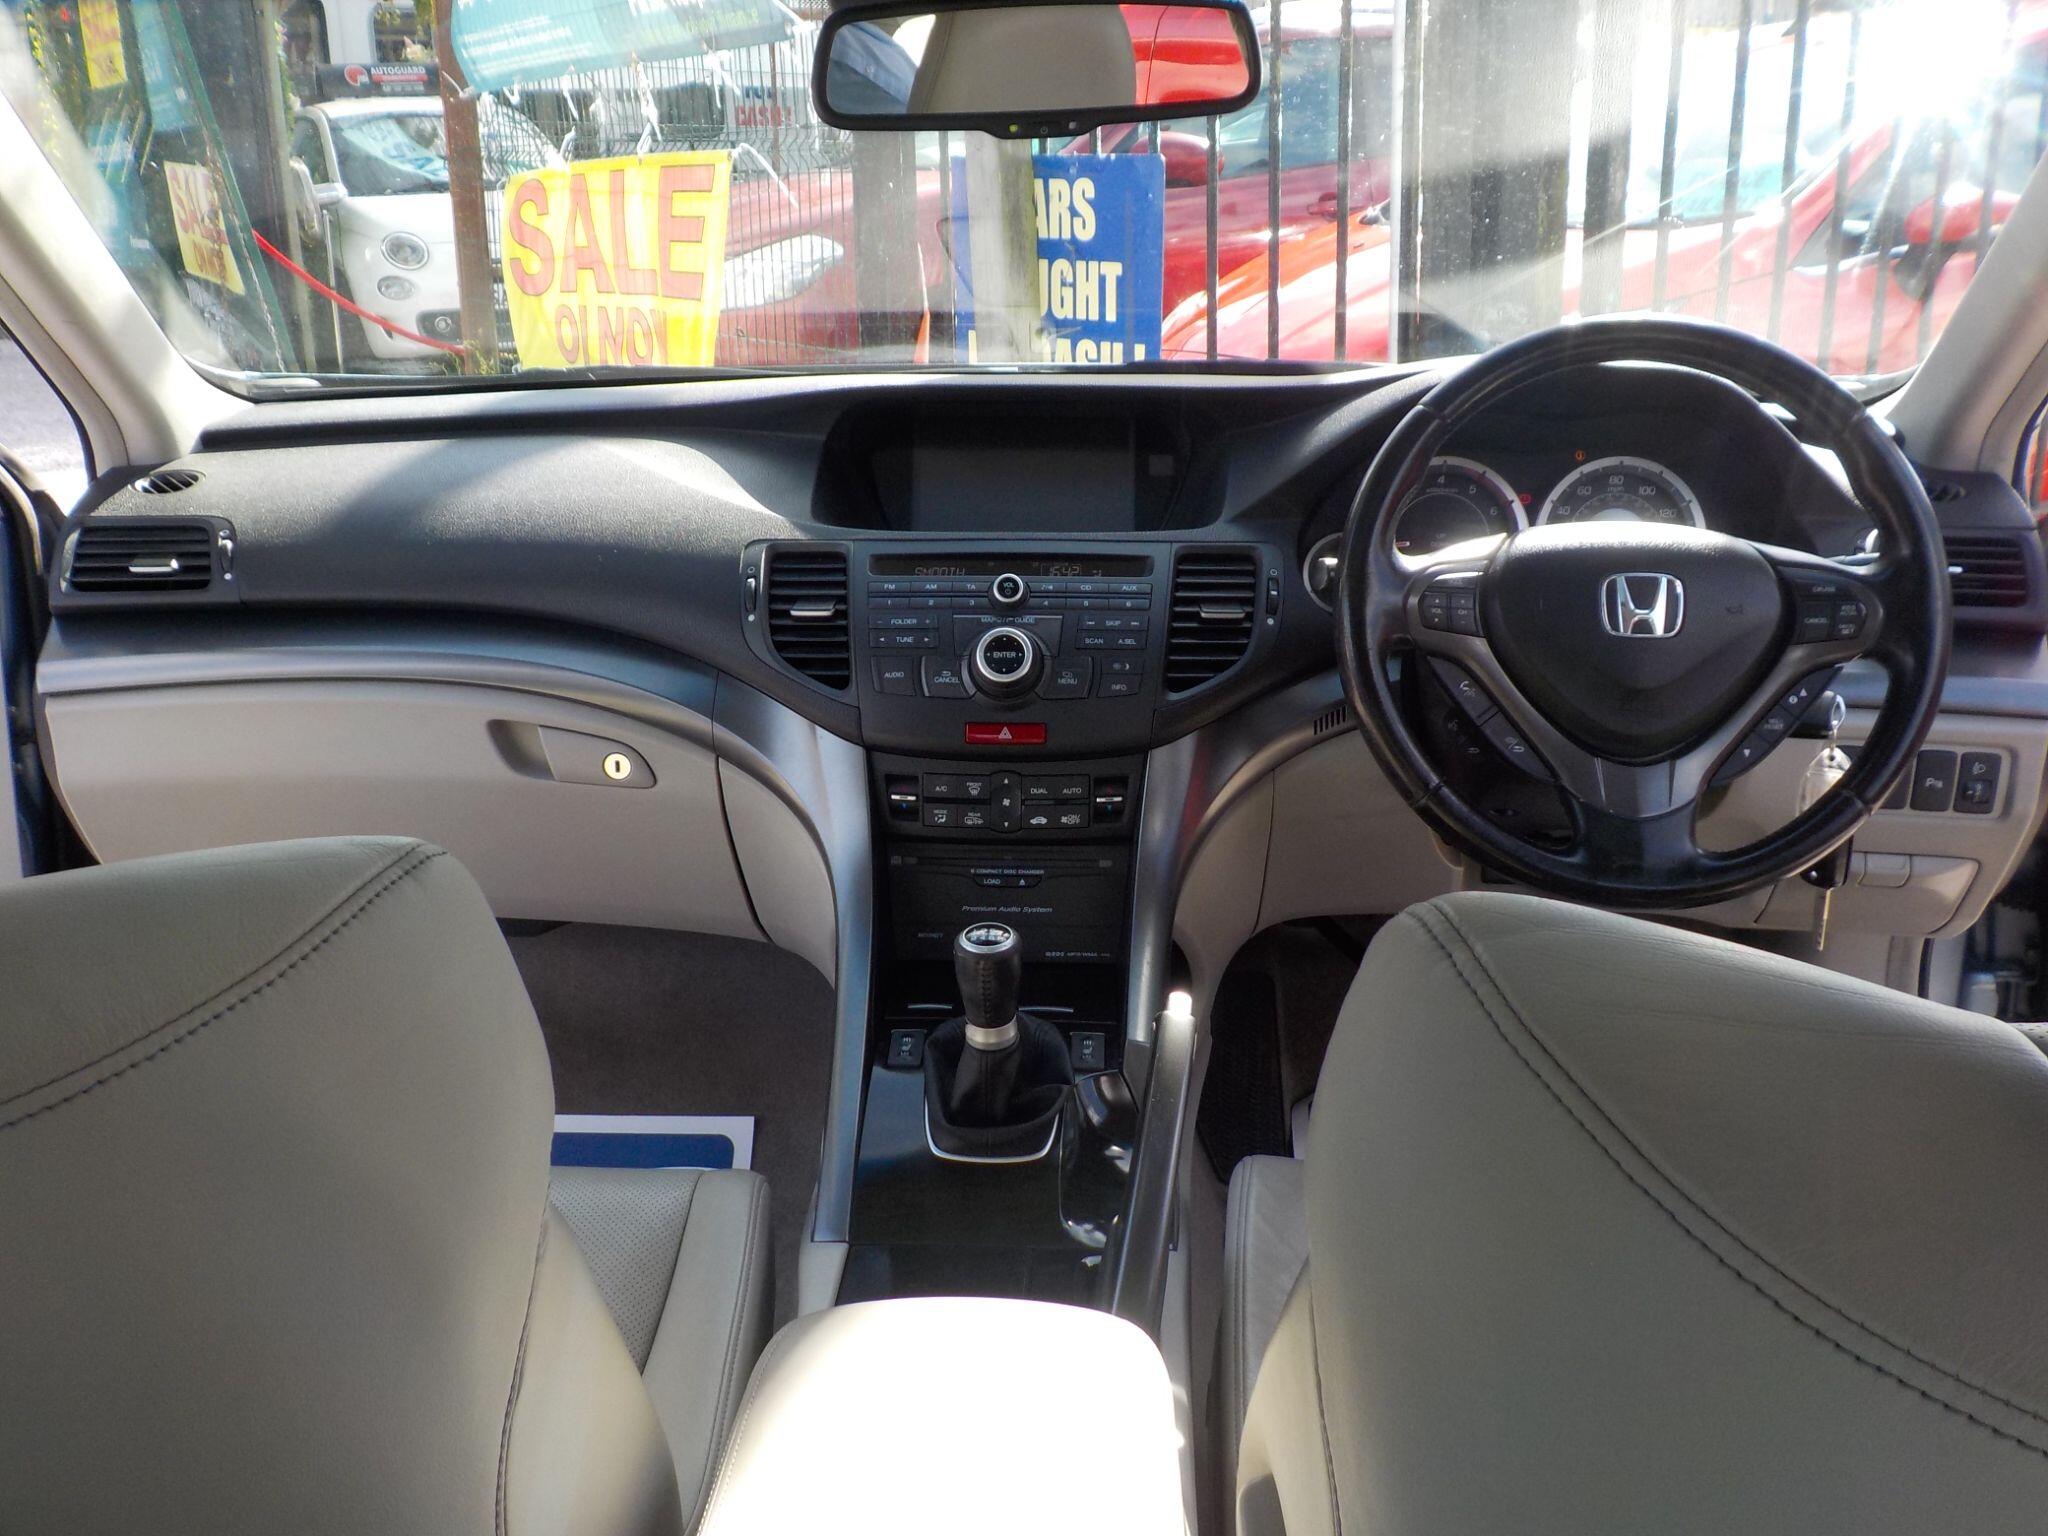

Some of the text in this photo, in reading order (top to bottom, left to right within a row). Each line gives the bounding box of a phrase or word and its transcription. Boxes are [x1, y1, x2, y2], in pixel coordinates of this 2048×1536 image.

[370, 66, 426, 75] AUTOGUARD
[1033, 176, 1097, 242] ARS
[508, 163, 715, 301] SALE
[1638, 486, 1656, 496] 100
[993, 651, 1017, 659] ENTER
[884, 671, 905, 679] AUDIO
[934, 676, 960, 684] CANCEL
[1062, 787, 1082, 795] AUTO
[1022, 906, 1053, 914] System
